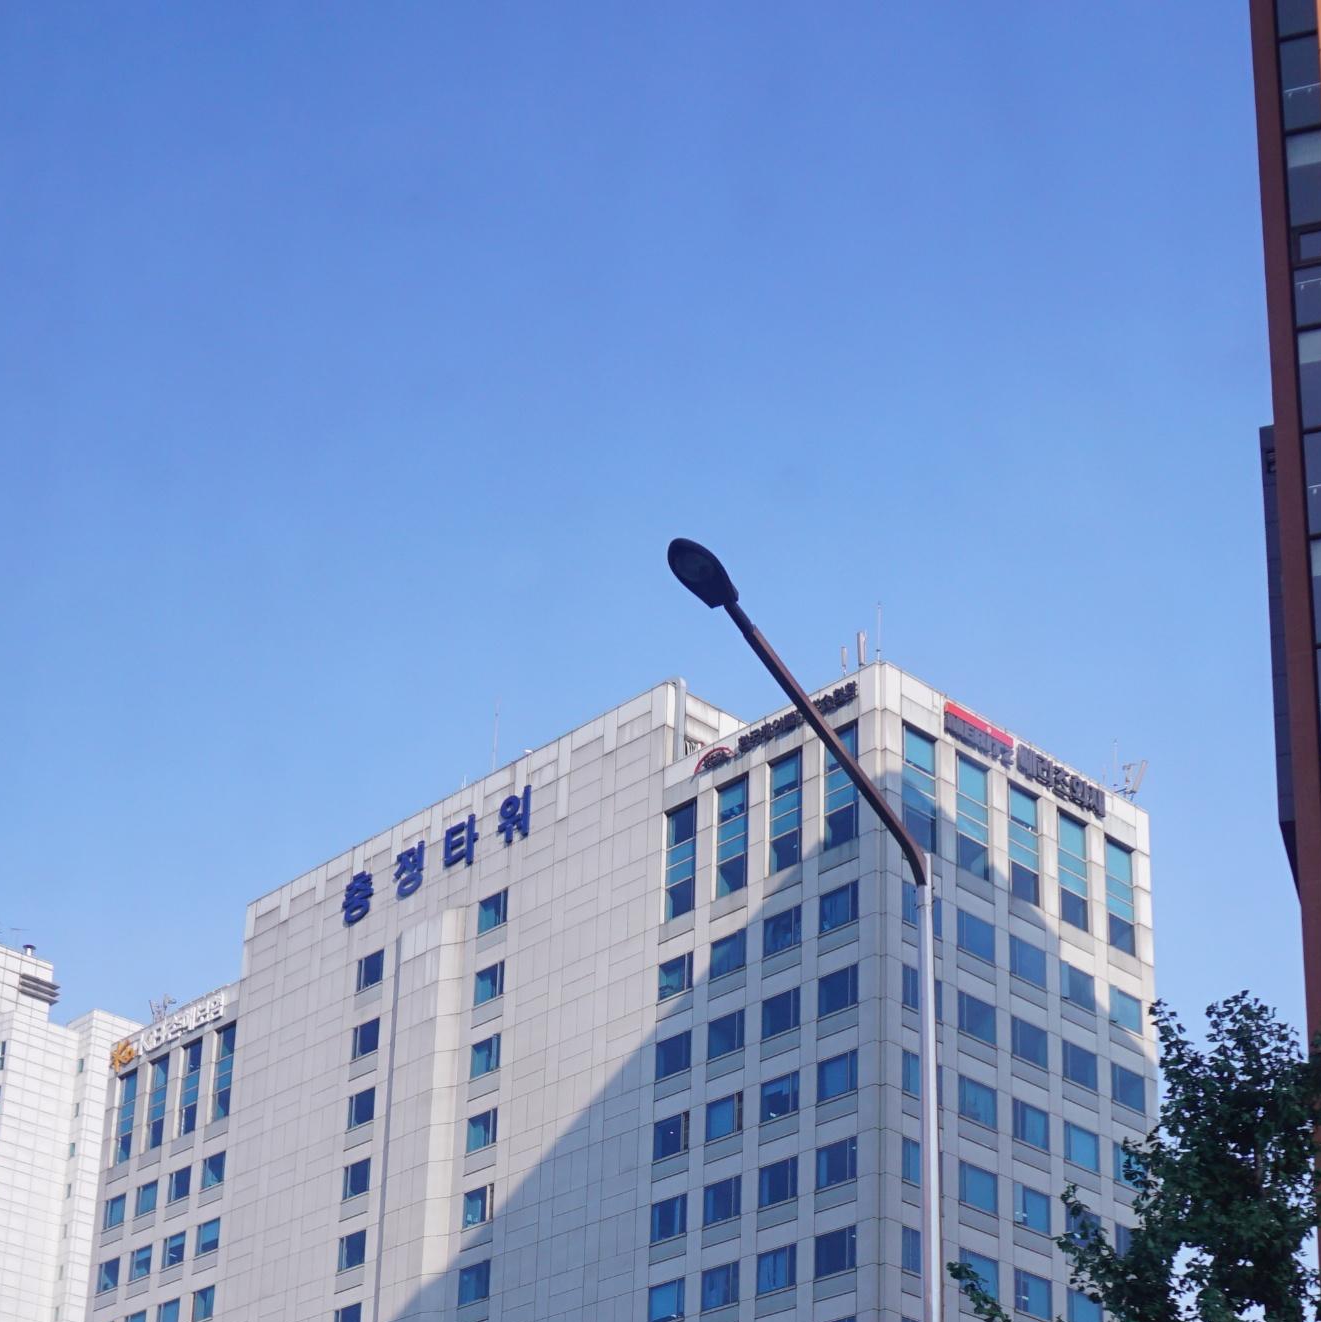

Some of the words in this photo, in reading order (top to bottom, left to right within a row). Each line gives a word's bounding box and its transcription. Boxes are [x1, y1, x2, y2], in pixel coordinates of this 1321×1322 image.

[943, 711, 1015, 769] MERITZ
[1016, 743, 1106, 818] 메리츠화재
[341, 784, 532, 927] 충정타워
[139, 990, 225, 1056] KB손해보험
